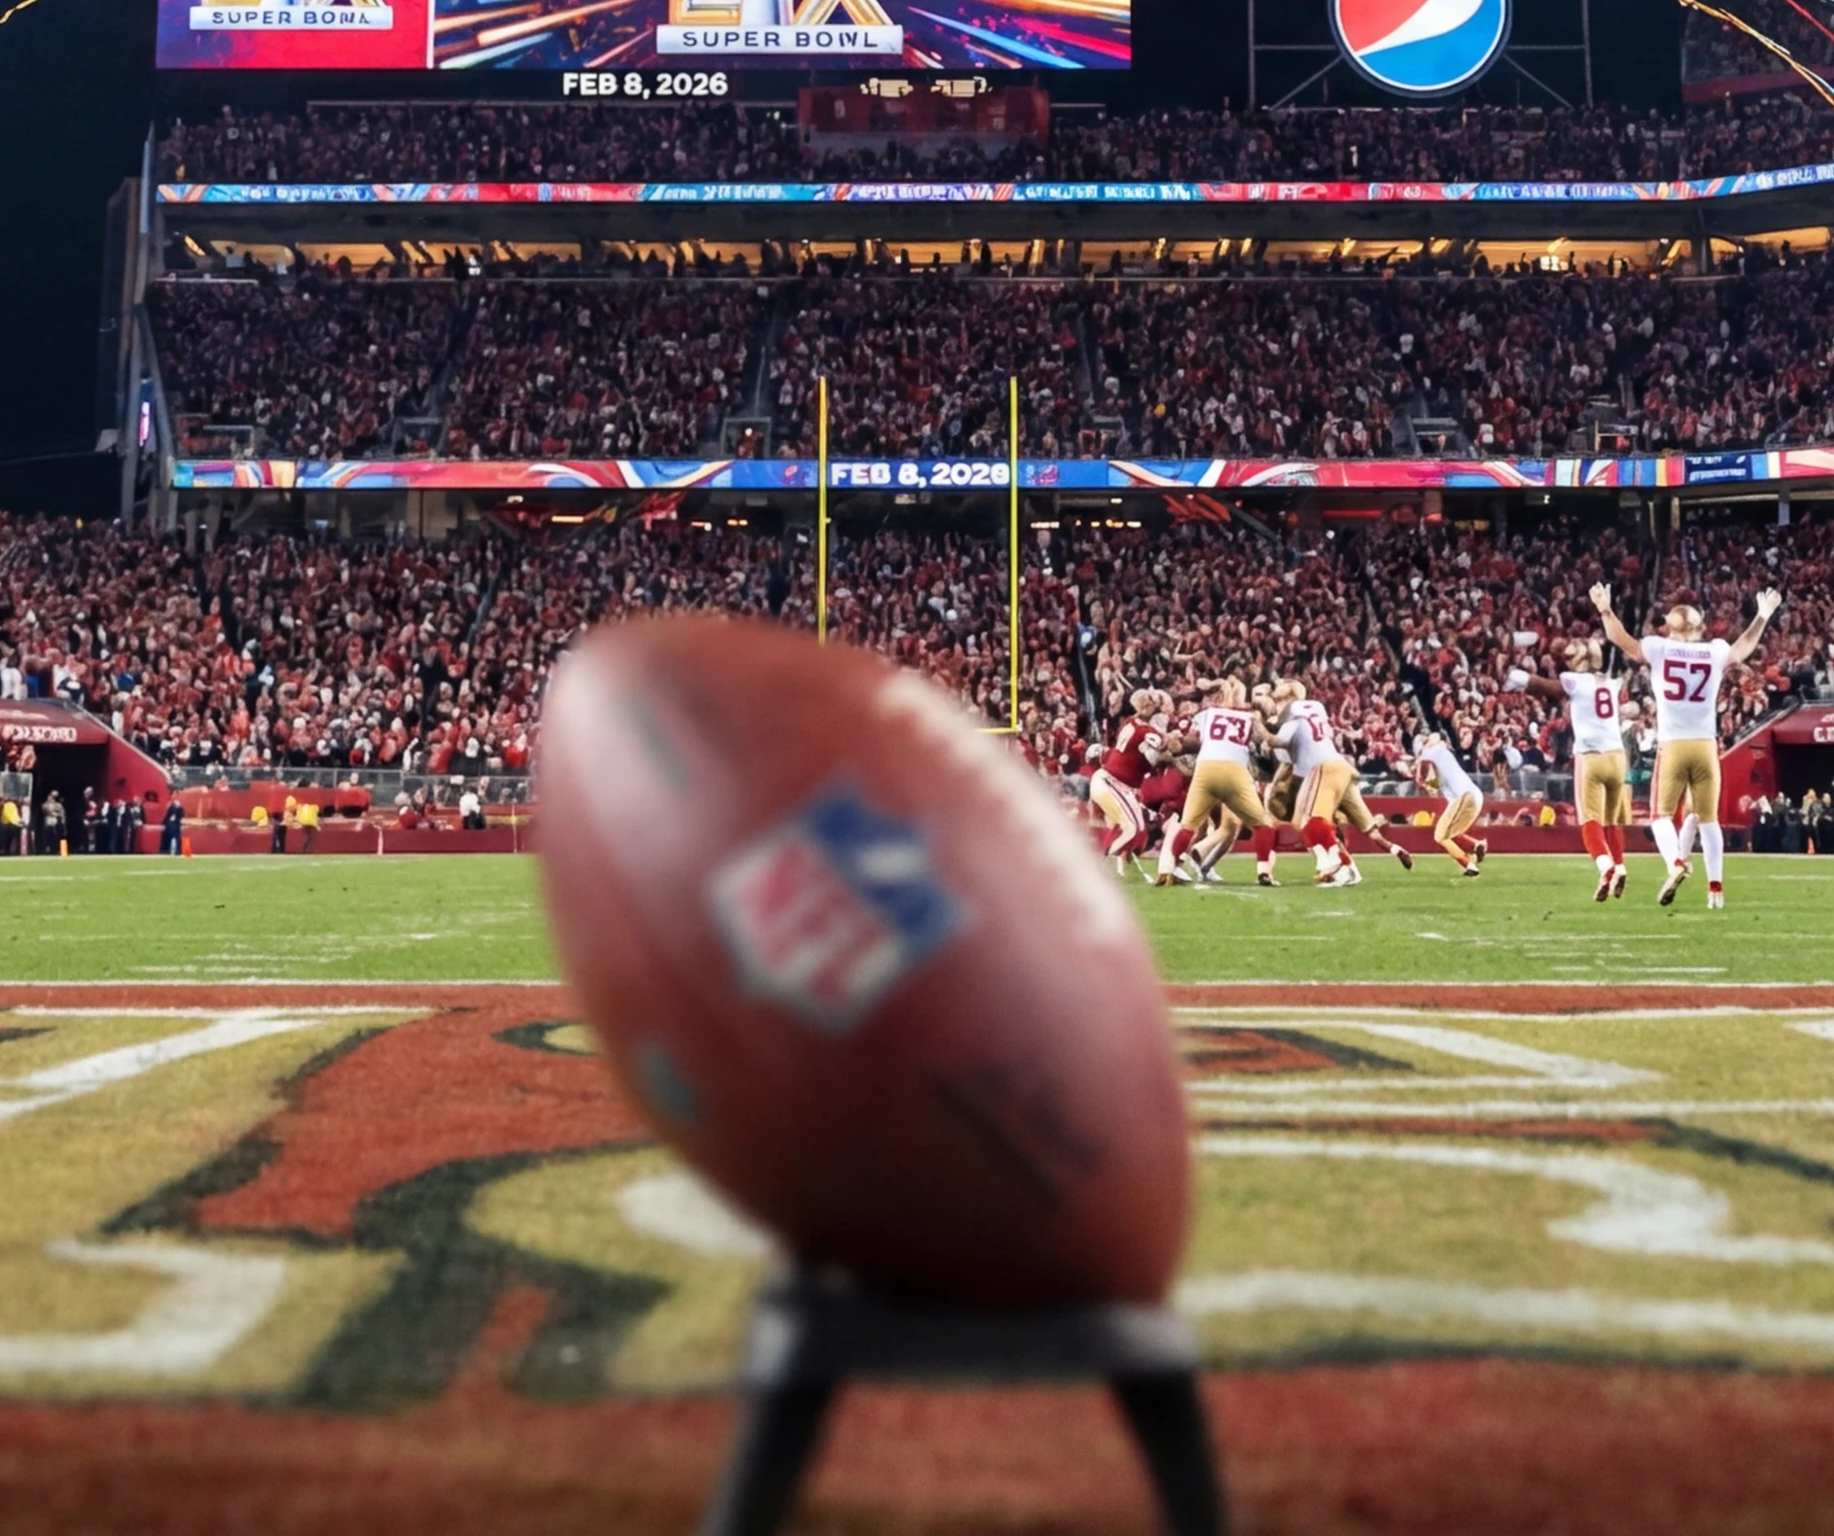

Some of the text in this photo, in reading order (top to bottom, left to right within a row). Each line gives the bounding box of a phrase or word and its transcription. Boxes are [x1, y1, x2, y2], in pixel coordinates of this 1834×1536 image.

[212, 10, 292, 25] SUPER
[682, 31, 780, 47] SUPER
[563, 72, 728, 100] FEB 8, 2026
[831, 463, 891, 486] FEB
